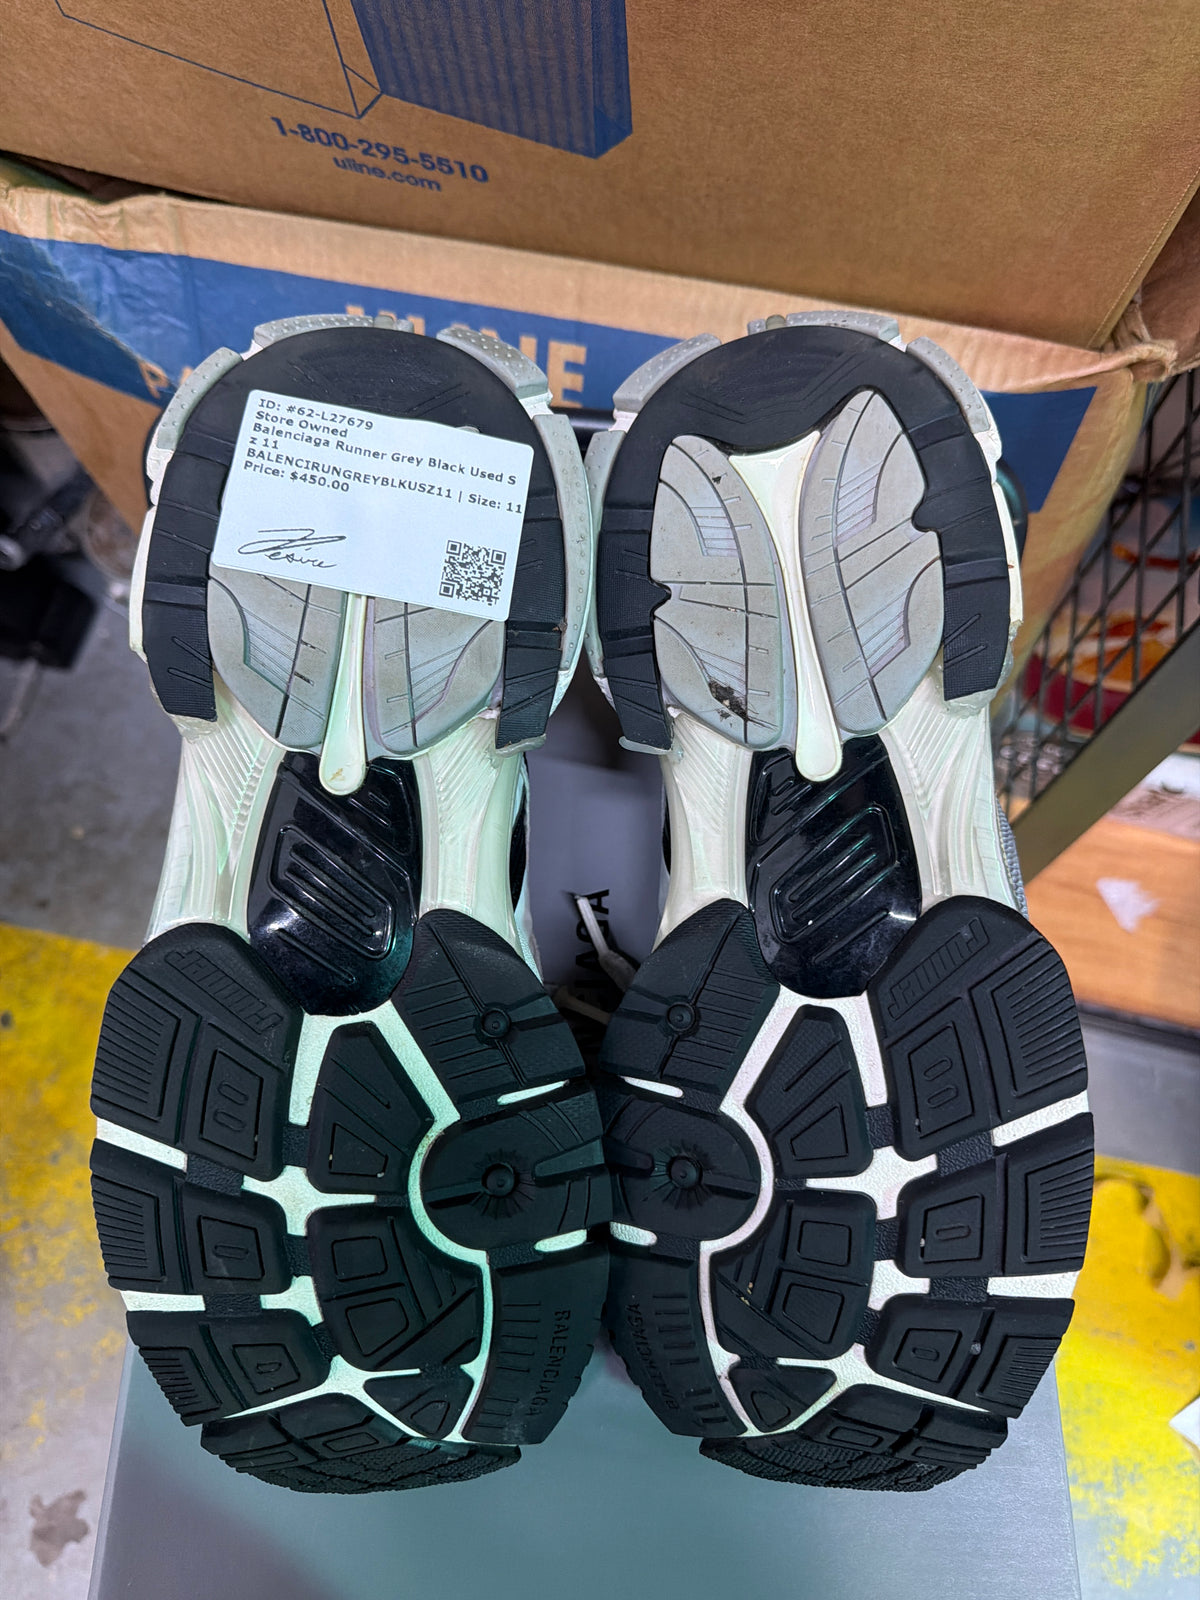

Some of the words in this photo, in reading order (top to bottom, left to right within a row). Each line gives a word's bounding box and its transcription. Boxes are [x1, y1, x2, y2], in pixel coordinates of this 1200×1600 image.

[270, 116, 489, 183] 1-800-295-5510
[332, 157, 442, 192] uline.com
[255, 411, 294, 426] Store
[298, 420, 349, 438] Owned
[258, 398, 280, 411] ID:
[286, 405, 374, 430] #62-L27679
[252, 423, 330, 447] Balenciaga
[336, 440, 387, 460] Runner
[391, 452, 424, 467] Grey
[428, 457, 465, 475] Black
[470, 467, 504, 482] Used
[507, 475, 517, 485] S
[262, 438, 279, 449] 11
[243, 460, 285, 478] Price:
[289, 470, 350, 492] $450.00
[247, 447, 452, 498] BALENCIRUNGREYBLKUSZ11
[468, 494, 501, 509] Size:
[506, 502, 522, 514] 11
[525, 1309, 571, 1417] BALENCIAGA
